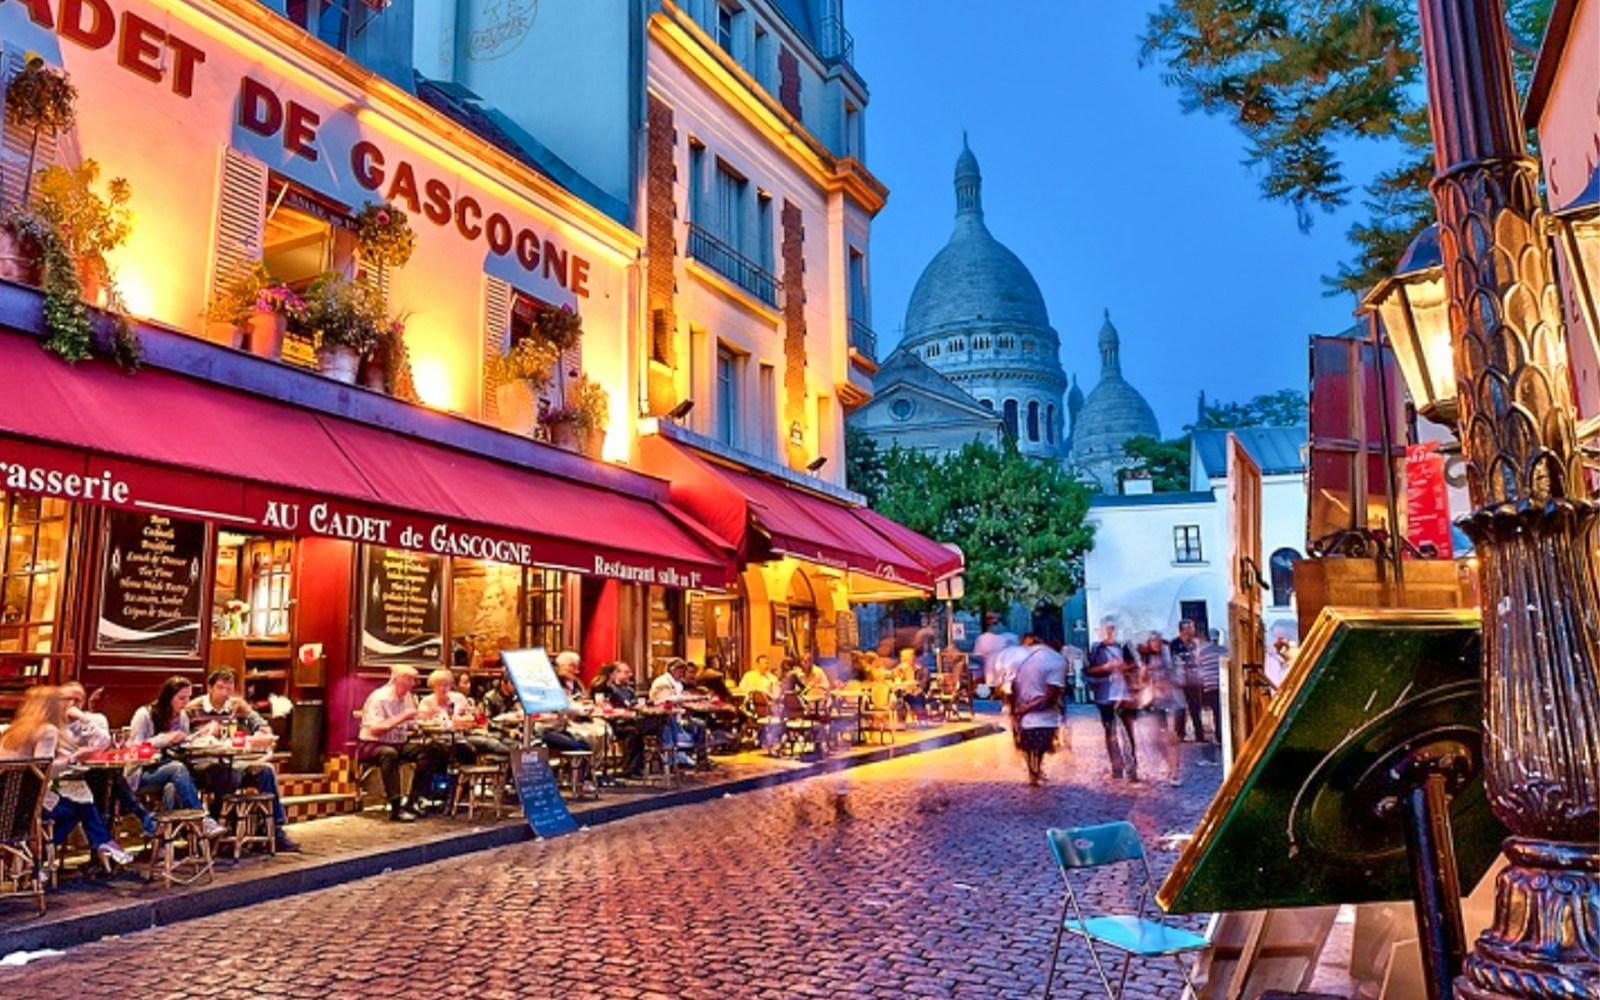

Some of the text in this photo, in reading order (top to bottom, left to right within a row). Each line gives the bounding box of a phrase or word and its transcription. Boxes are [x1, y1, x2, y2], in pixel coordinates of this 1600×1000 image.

[239, 75, 320, 162] DE
[350, 140, 590, 298] GASCOGNE
[262, 501, 532, 565] AU CADET de GASCOGNE
[594, 555, 655, 582] Restaurant
